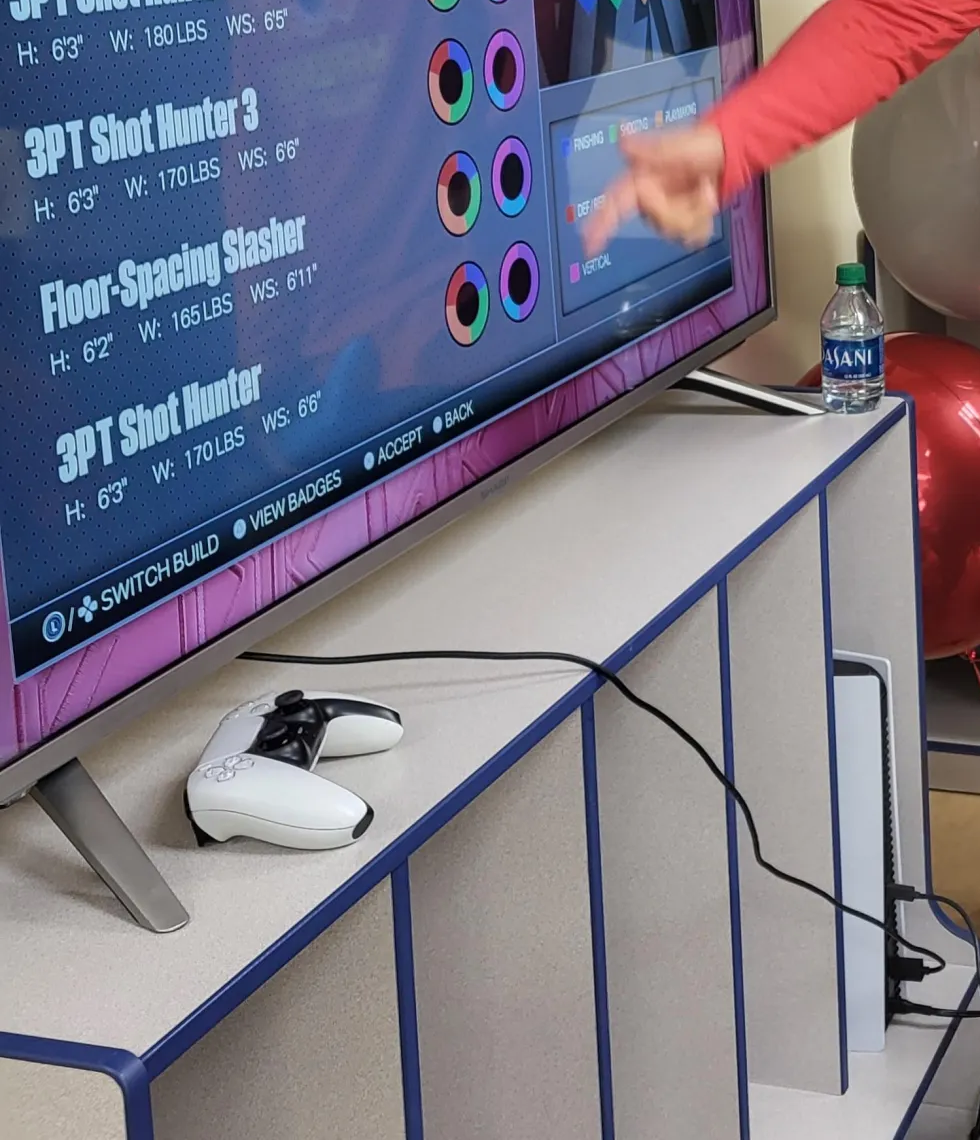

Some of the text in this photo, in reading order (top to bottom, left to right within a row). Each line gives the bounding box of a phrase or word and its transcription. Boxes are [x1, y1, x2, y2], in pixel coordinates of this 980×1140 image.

[17, 41, 39, 66] H:
[52, 34, 83, 61] 6'3"
[110, 28, 133, 53] W:
[226, 13, 256, 36] WS:
[24, 87, 259, 179] 3PT Shot Hunter 3
[33, 198, 55, 223] H:
[68, 185, 99, 214] 6'3"
[124, 175, 147, 200] W:
[238, 147, 268, 171] WS:
[39, 215, 306, 334] Floor-Spacing Slasher
[581, 253, 612, 276] VERTICAL
[50, 350, 71, 376] H:
[82, 332, 113, 364] 6'2"
[138, 318, 161, 344] W:
[250, 278, 279, 304] WS:
[56, 363, 262, 484] 3PT Shot Hunter
[378, 426, 423, 466] ACCEPT
[445, 399, 474, 429] BACK
[65, 499, 86, 526] H:
[97, 476, 128, 511] 6'3"
[152, 458, 175, 484] W:
[261, 408, 290, 434] WS:
[250, 469, 342, 531] VIEW BADGES
[101, 533, 220, 611] SWITCH BUILD
